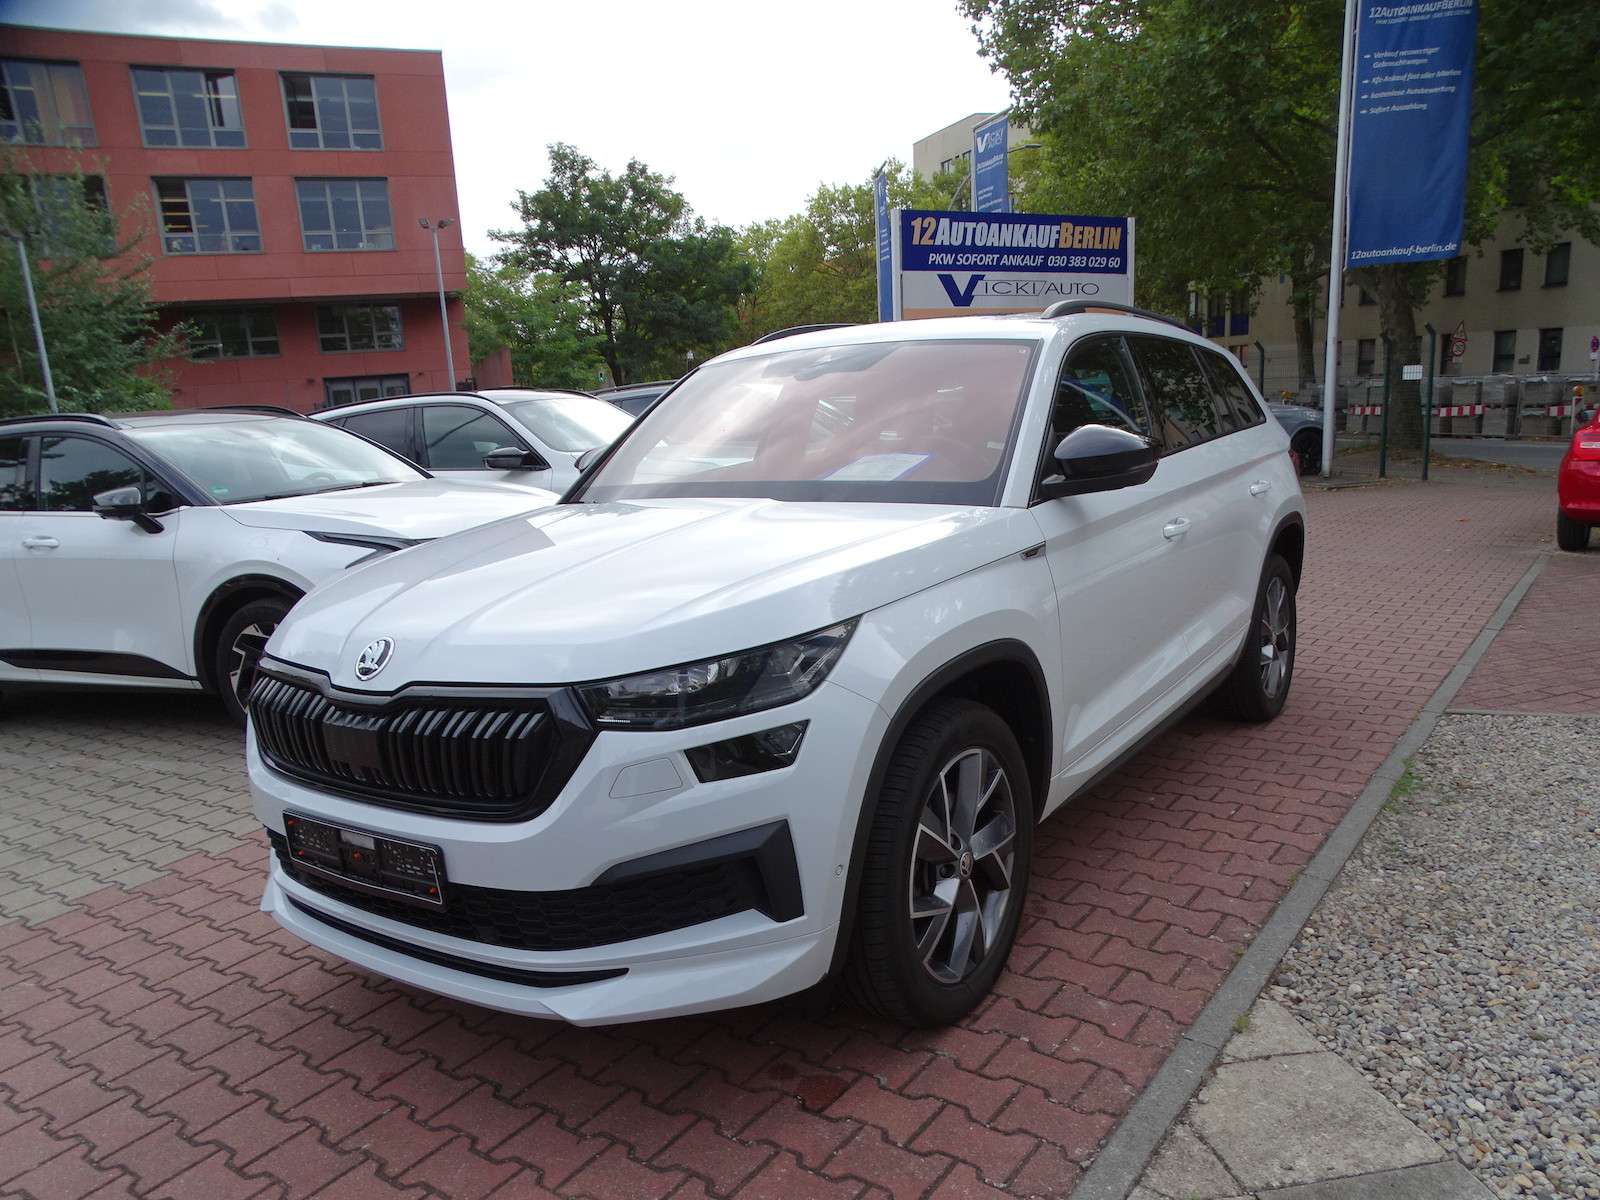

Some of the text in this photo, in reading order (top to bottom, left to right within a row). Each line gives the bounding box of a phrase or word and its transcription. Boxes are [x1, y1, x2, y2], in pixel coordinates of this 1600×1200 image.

[1351, 242, 1457, 260] 12autoankauf-berlin.de
[928, 253, 1121, 269] PKW SOFORT ANKAUF 030 383 029 60
